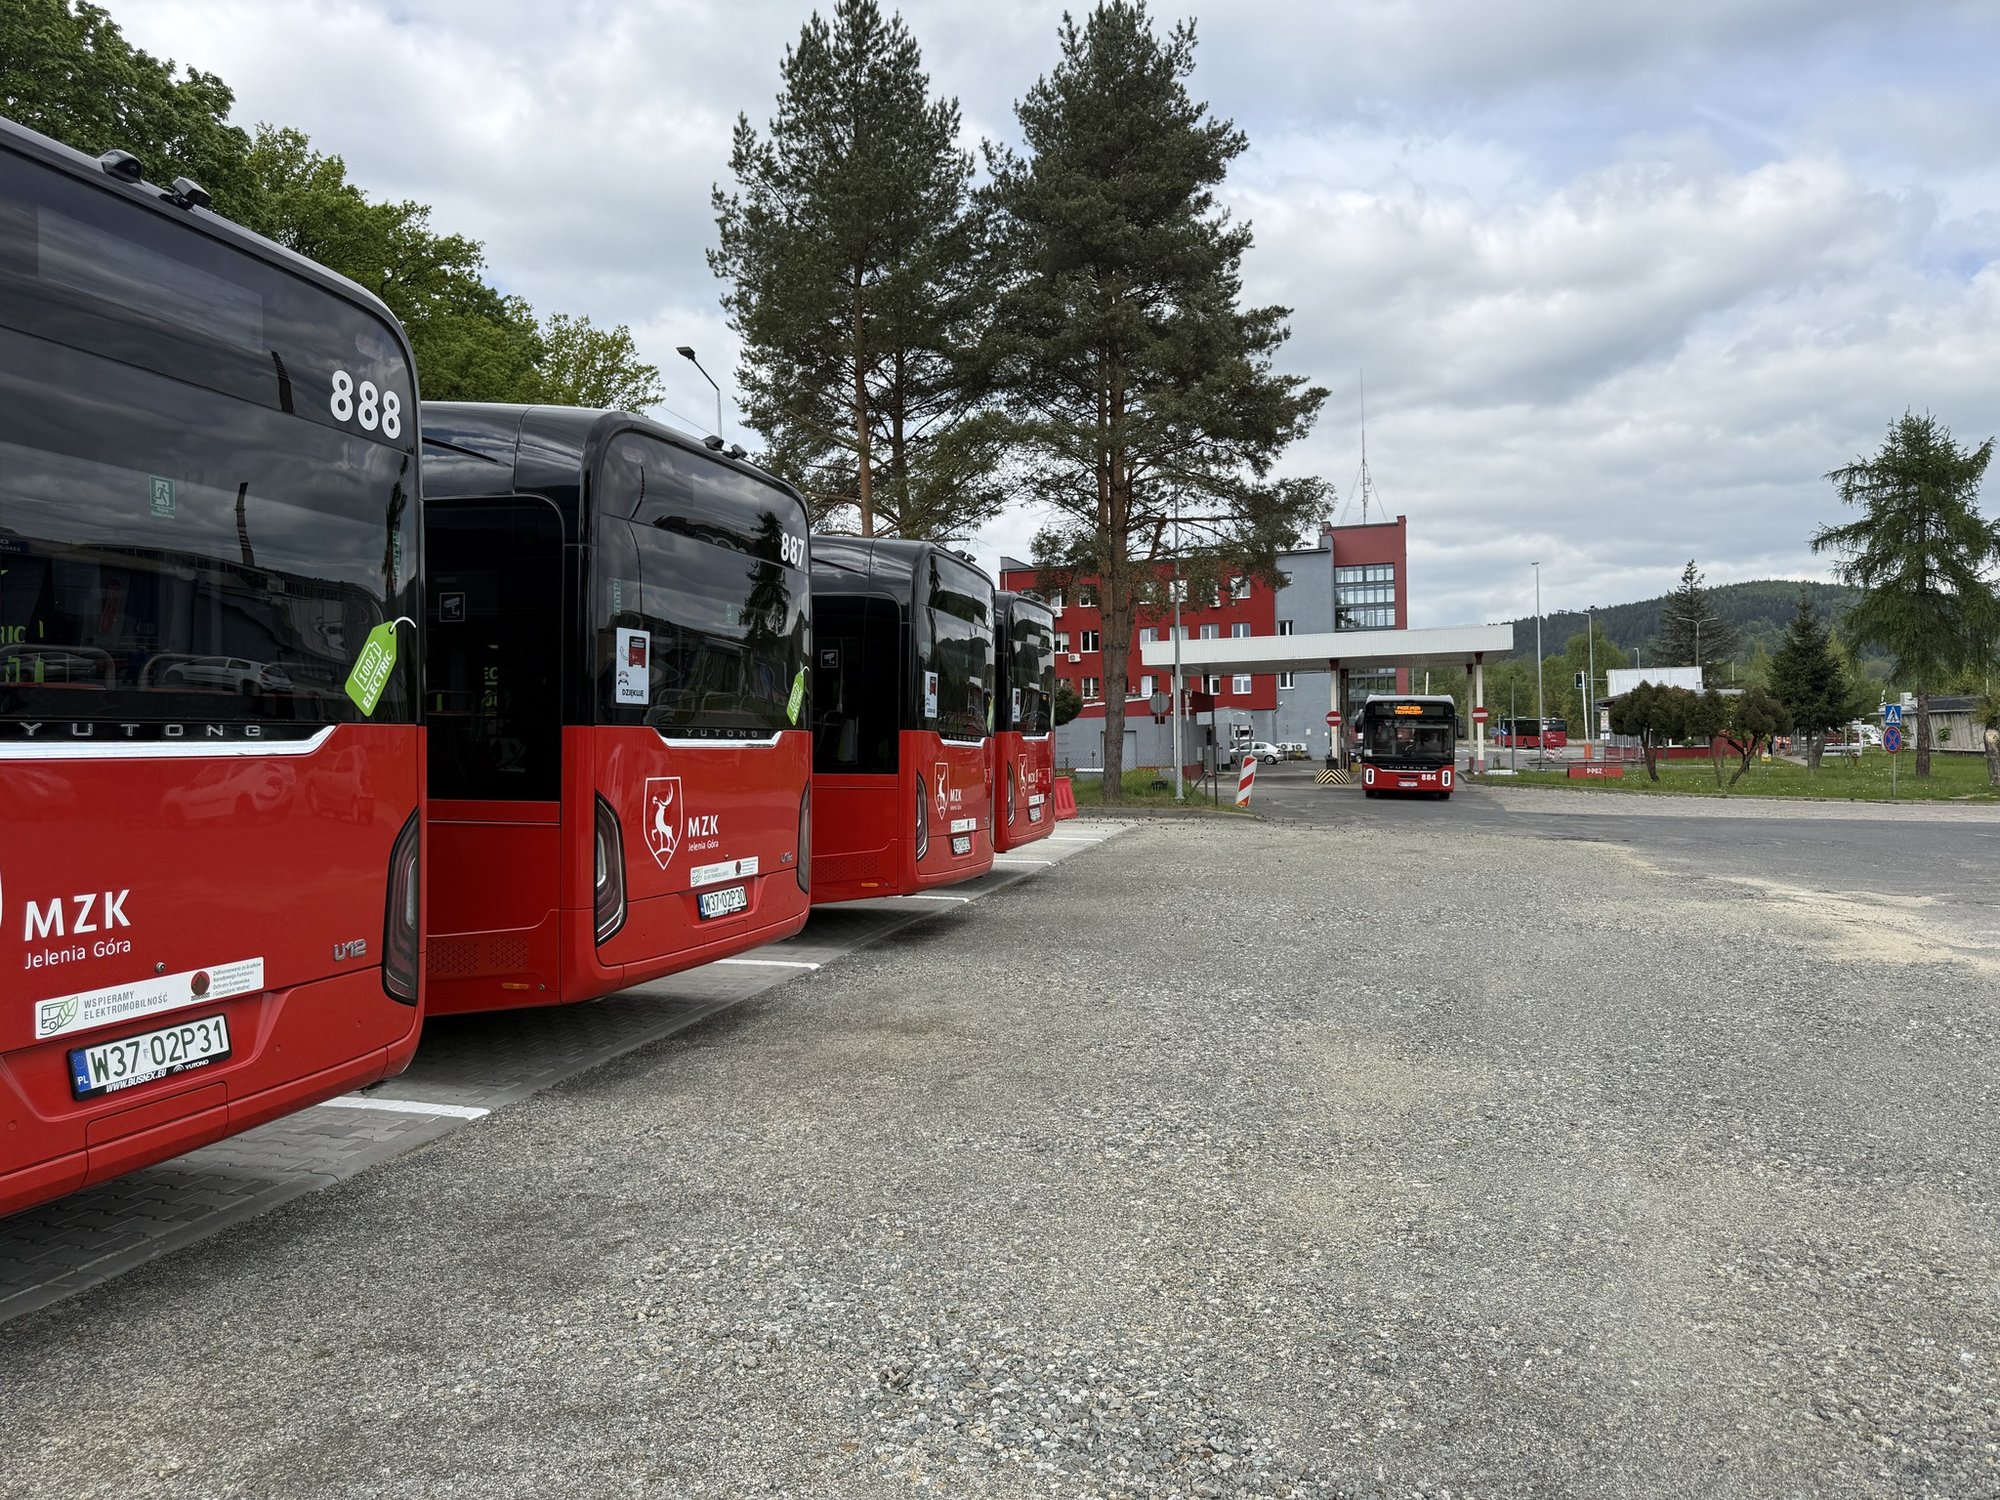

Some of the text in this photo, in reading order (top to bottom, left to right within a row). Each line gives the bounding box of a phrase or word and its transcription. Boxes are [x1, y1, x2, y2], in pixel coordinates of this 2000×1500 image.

[330, 369, 402, 440] 888
[780, 532, 805, 567] 887
[358, 650, 377, 685] 100%
[362, 649, 394, 710] ELECTRIC
[19, 721, 262, 737] YUTONG
[685, 728, 759, 738] YUTONG
[1421, 773, 1437, 781] 884
[687, 814, 719, 838] MZK
[687, 838, 719, 852] Jelenia Góra
[703, 892, 720, 914] W37
[720, 887, 746, 909] 02P30
[24, 888, 132, 942] MZK
[24, 937, 132, 970] Jelenia Góra
[333, 938, 367, 961] U12
[83, 990, 135, 1009] WSPIERAMY
[84, 991, 168, 1020] ELEKTROMOBILNOŚĆ
[90, 1019, 225, 1083] W37 02P31
[77, 1076, 89, 1086] PL
